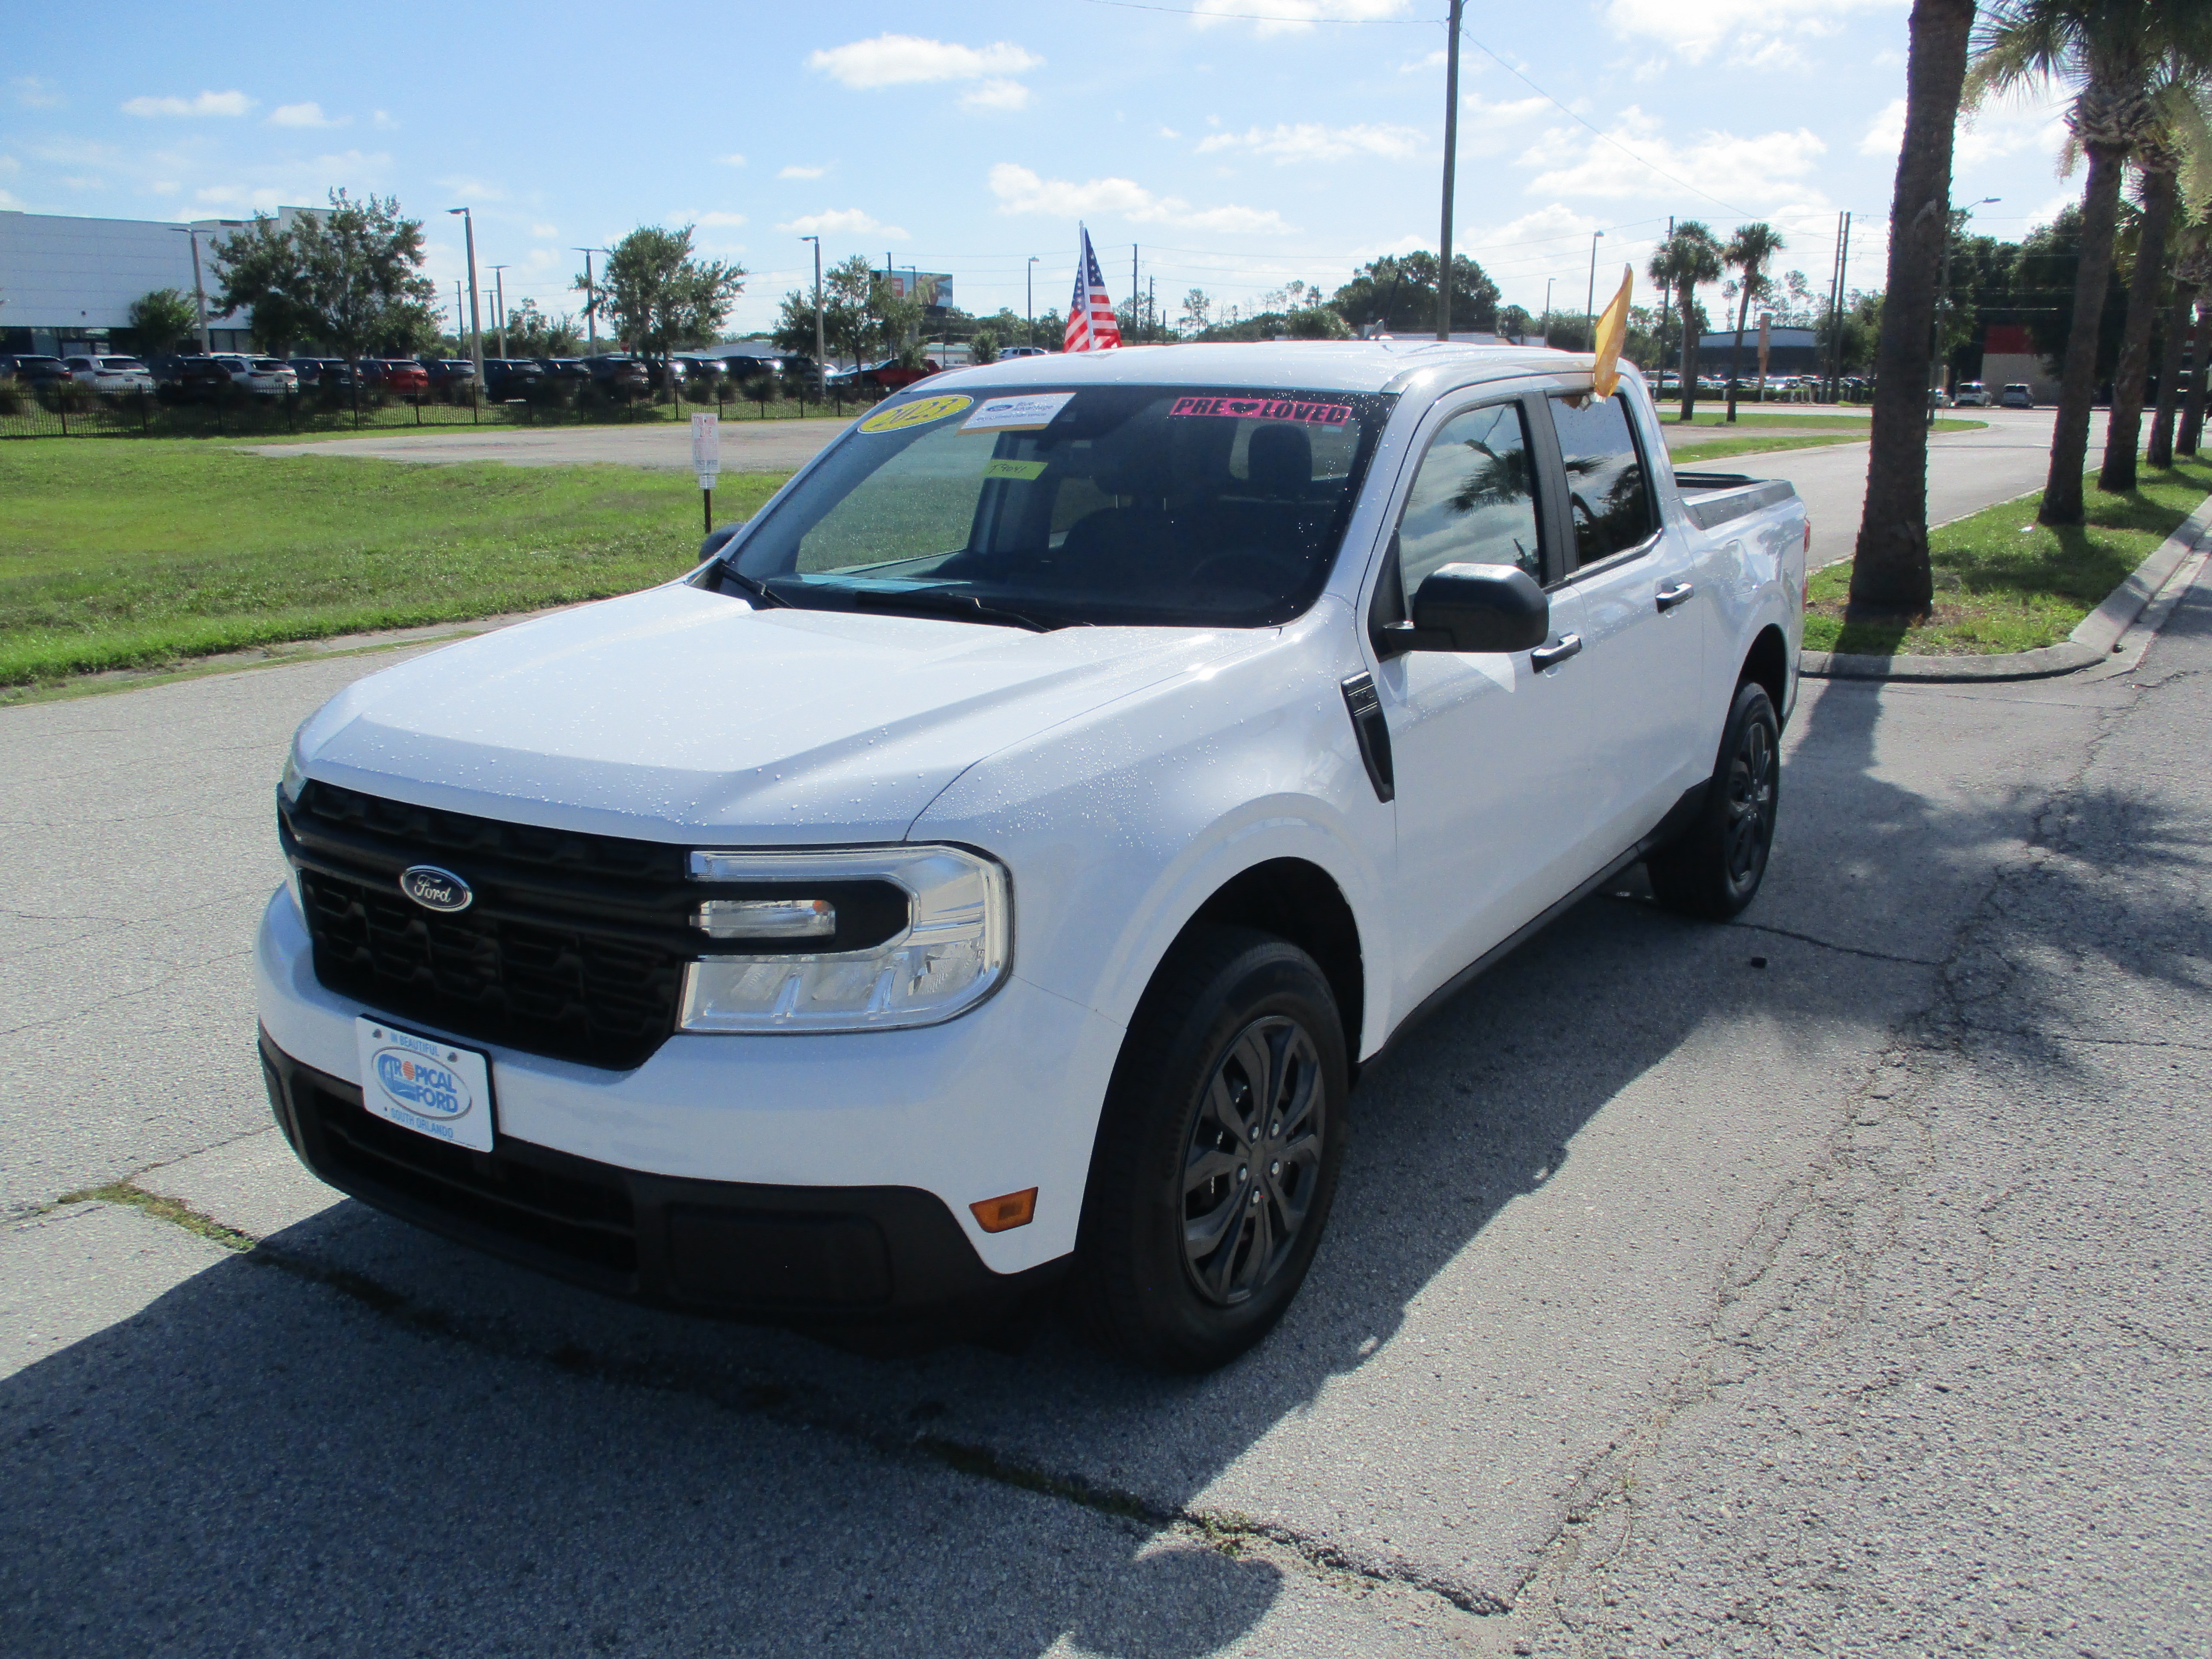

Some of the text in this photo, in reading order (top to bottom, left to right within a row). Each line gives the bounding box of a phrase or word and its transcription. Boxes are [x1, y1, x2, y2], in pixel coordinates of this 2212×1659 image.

[1174, 398, 1347, 422] PRE LOVED
[414, 874, 452, 903] Ford
[400, 1035, 440, 1057] BEAUTIFUL
[380, 1054, 457, 1094] TROPICAL
[416, 1085, 459, 1113] FORD
[390, 1107, 453, 1139] SOUTH ORLANDO
